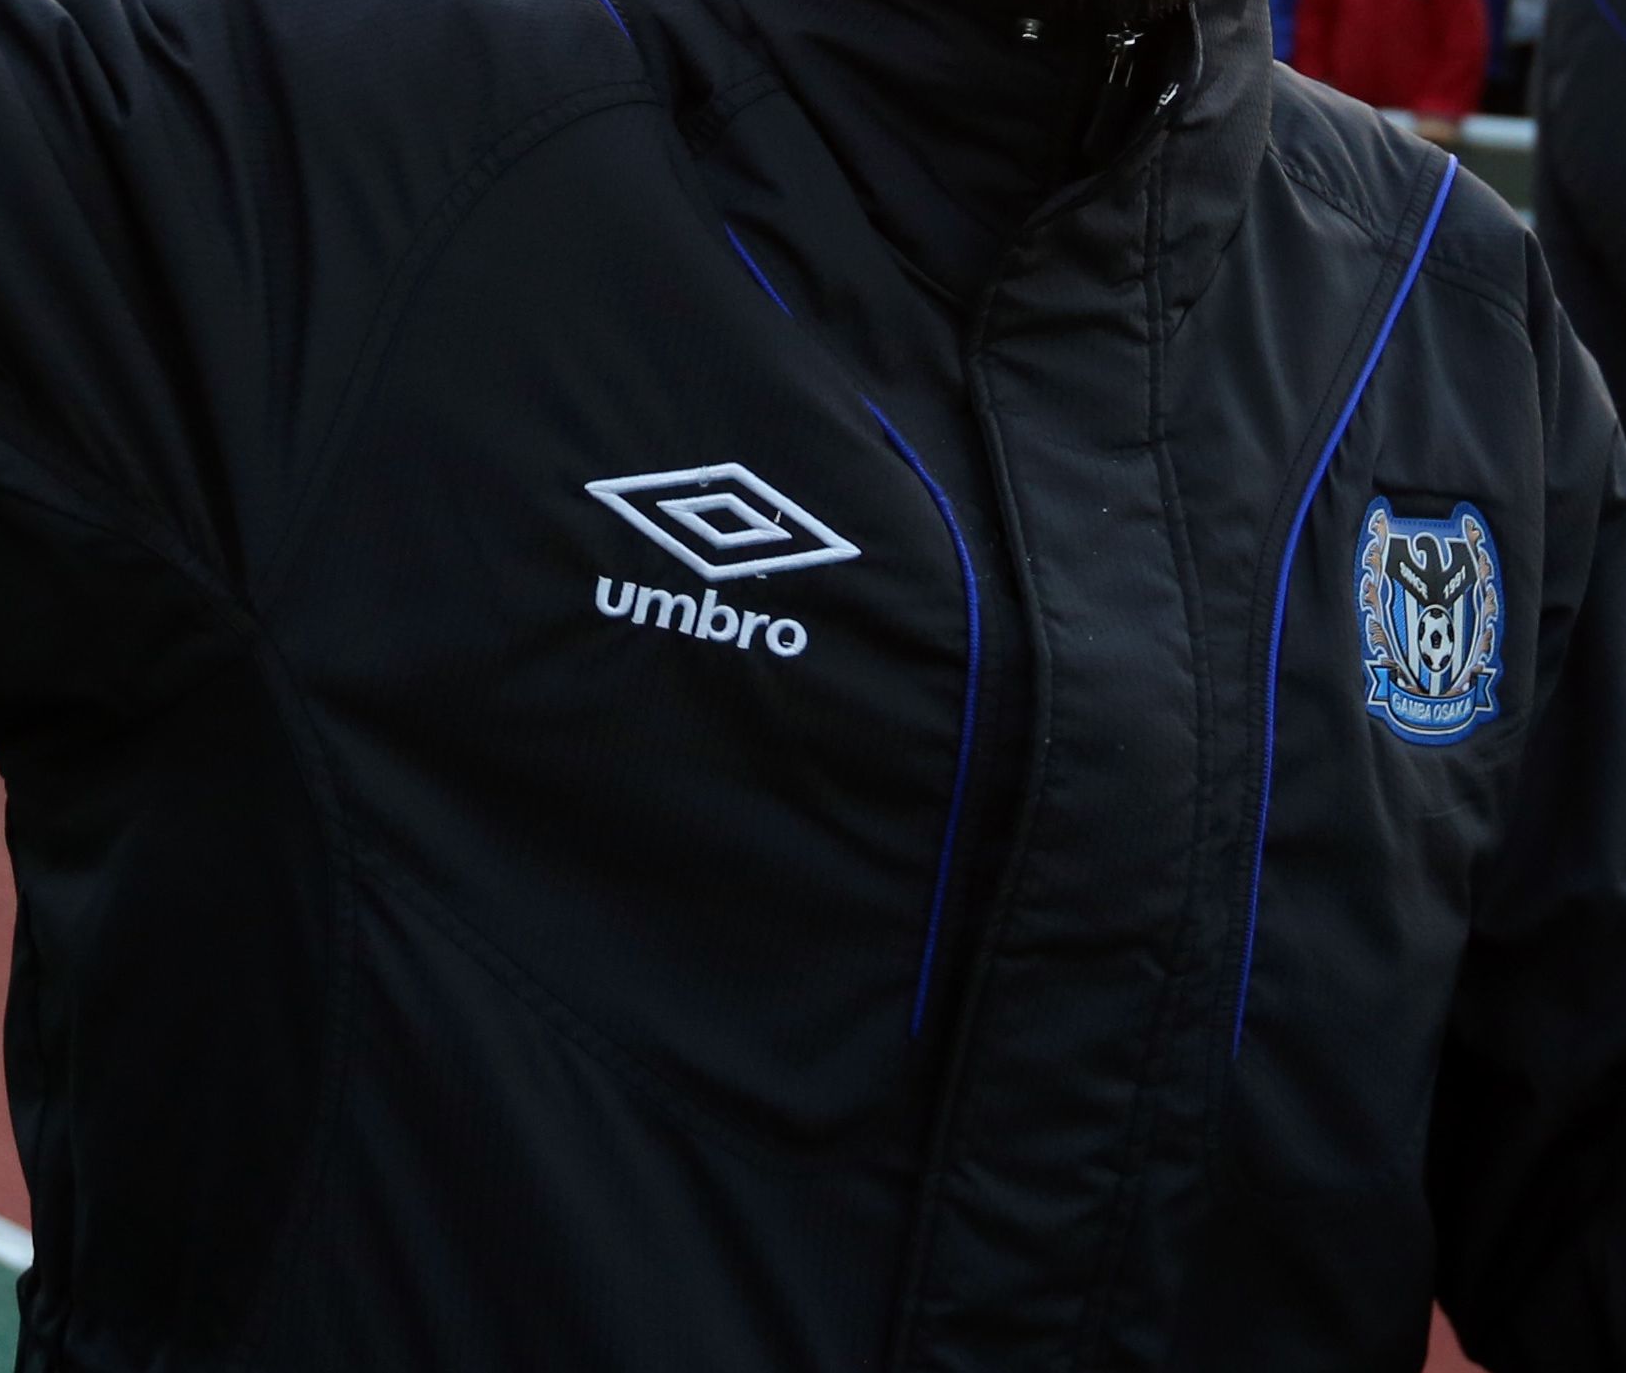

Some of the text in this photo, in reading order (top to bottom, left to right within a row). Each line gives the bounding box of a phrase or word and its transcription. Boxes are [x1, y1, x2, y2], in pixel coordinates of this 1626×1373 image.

[594, 575, 808, 657] umbro
[1392, 692, 1473, 721] GAMBA OSAKA
